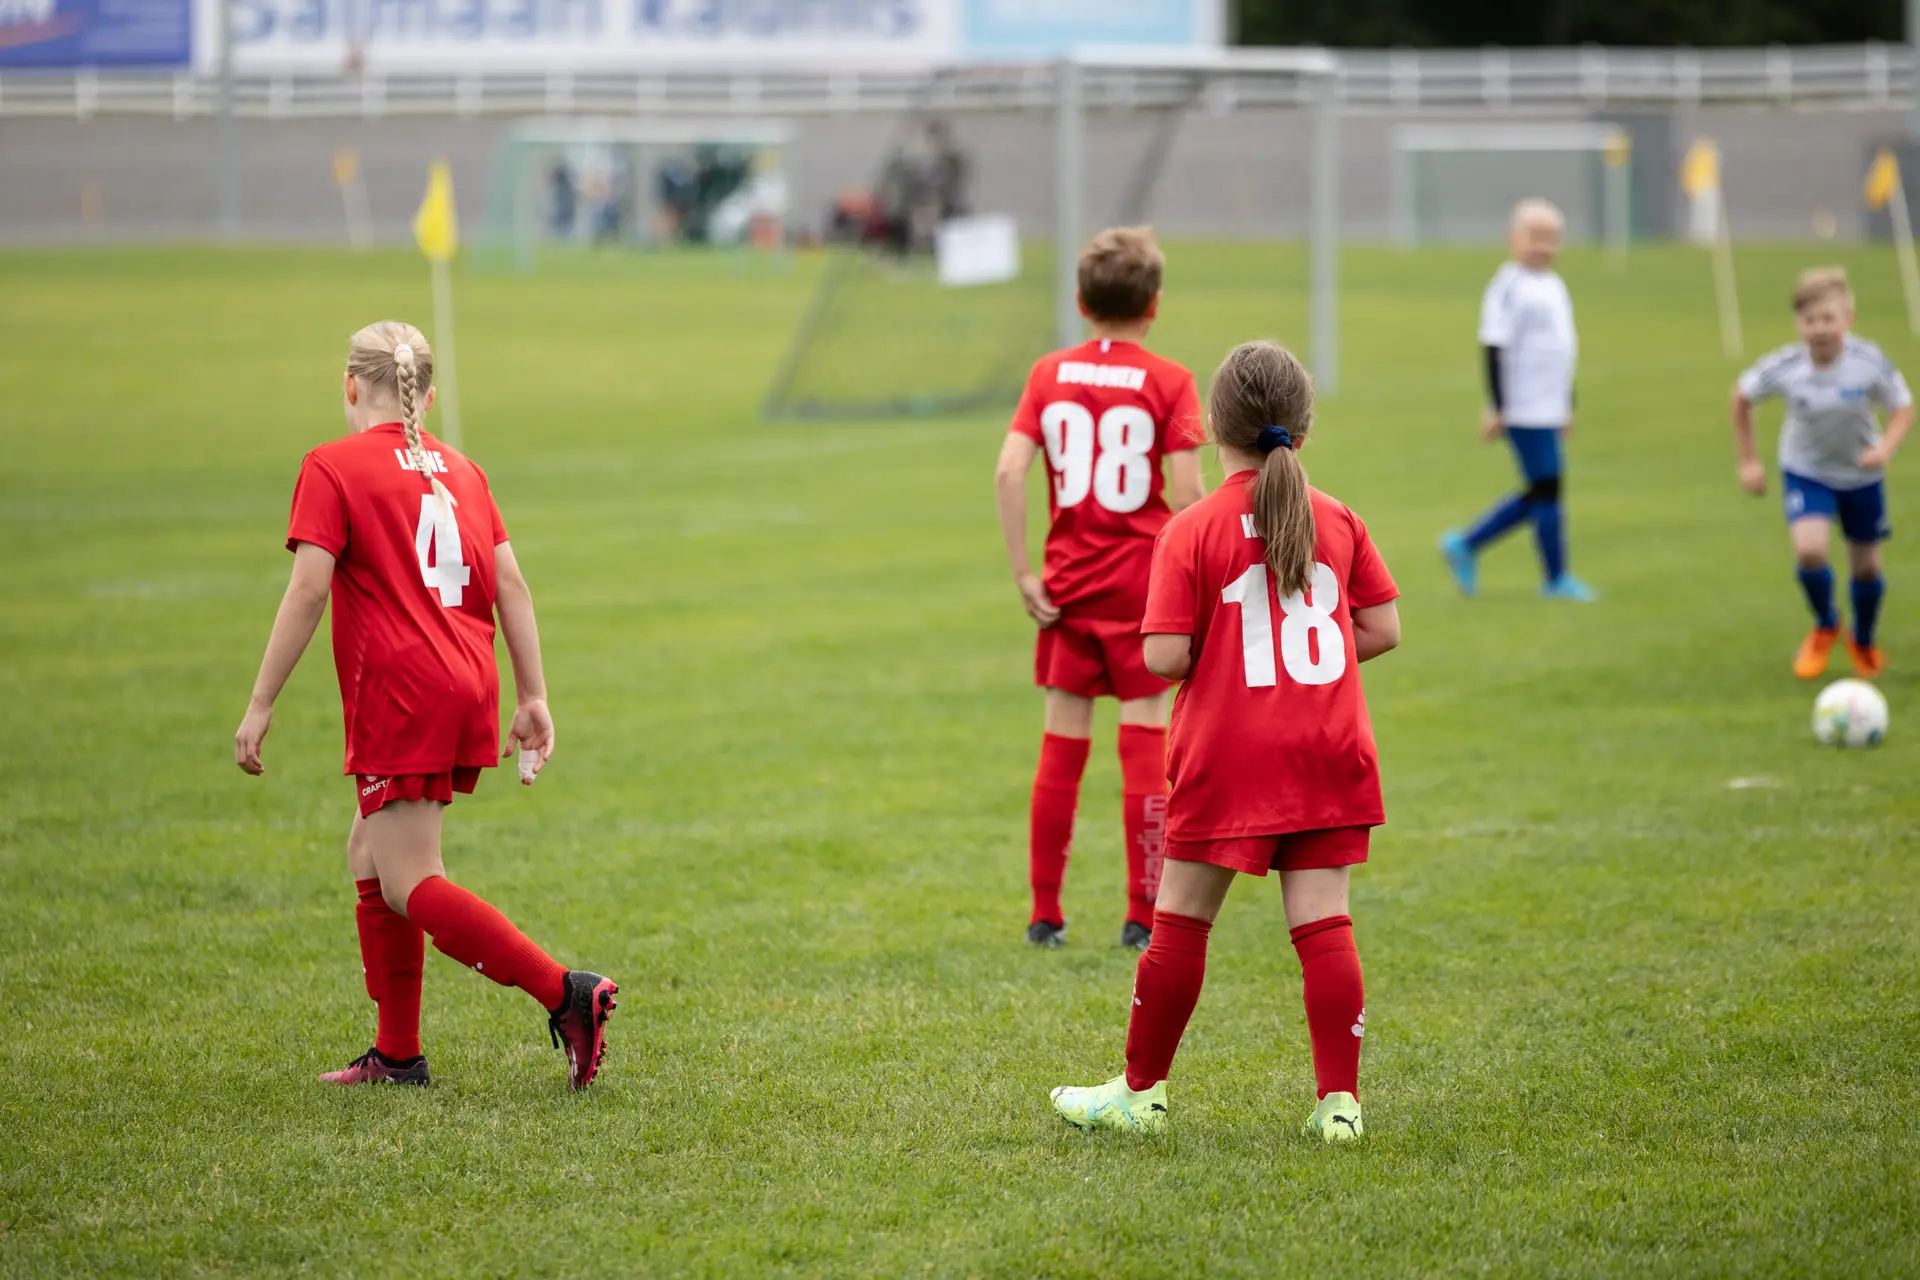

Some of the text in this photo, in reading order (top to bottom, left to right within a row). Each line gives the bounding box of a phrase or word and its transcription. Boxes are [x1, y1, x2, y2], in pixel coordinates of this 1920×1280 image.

[394, 448, 449, 473] LANE
[1040, 400, 1155, 514] 98
[415, 494, 470, 608] 4
[1221, 562, 1346, 688] 18
[362, 780, 387, 797] CRAFT
